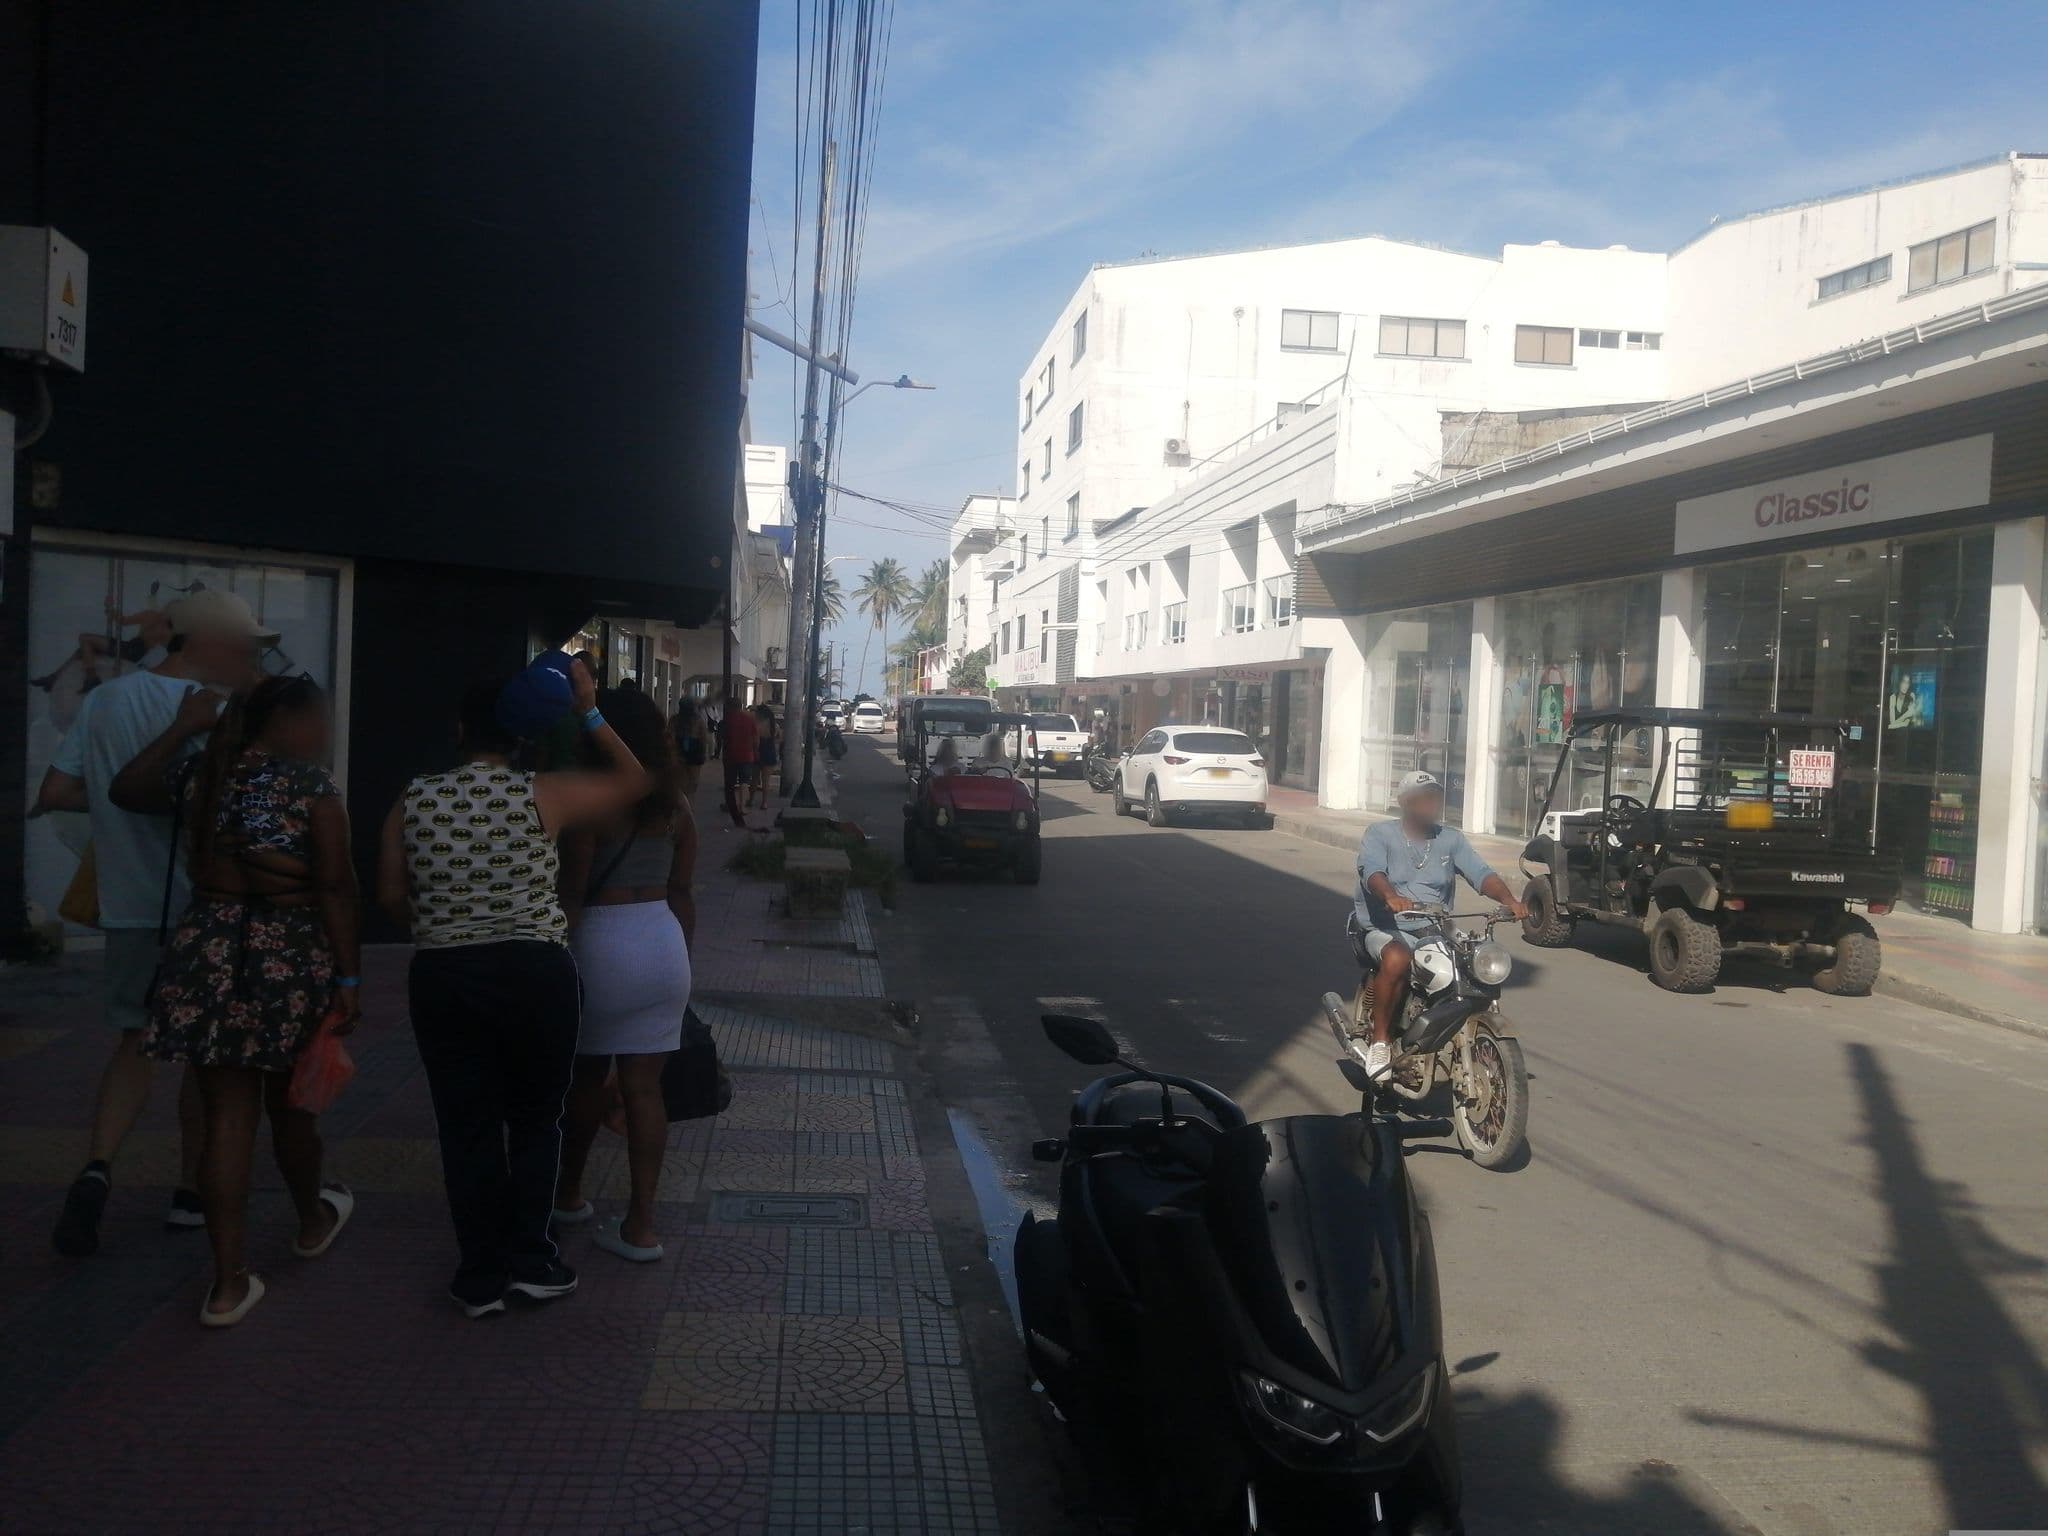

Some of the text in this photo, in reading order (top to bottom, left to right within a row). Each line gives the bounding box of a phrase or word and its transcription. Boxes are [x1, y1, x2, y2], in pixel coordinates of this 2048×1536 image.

[57, 315, 78, 347] 7317
[1754, 478, 1871, 528] Classic
[1792, 753, 1832, 768] SE RENTA
[1791, 871, 1845, 883] Kawasaki
